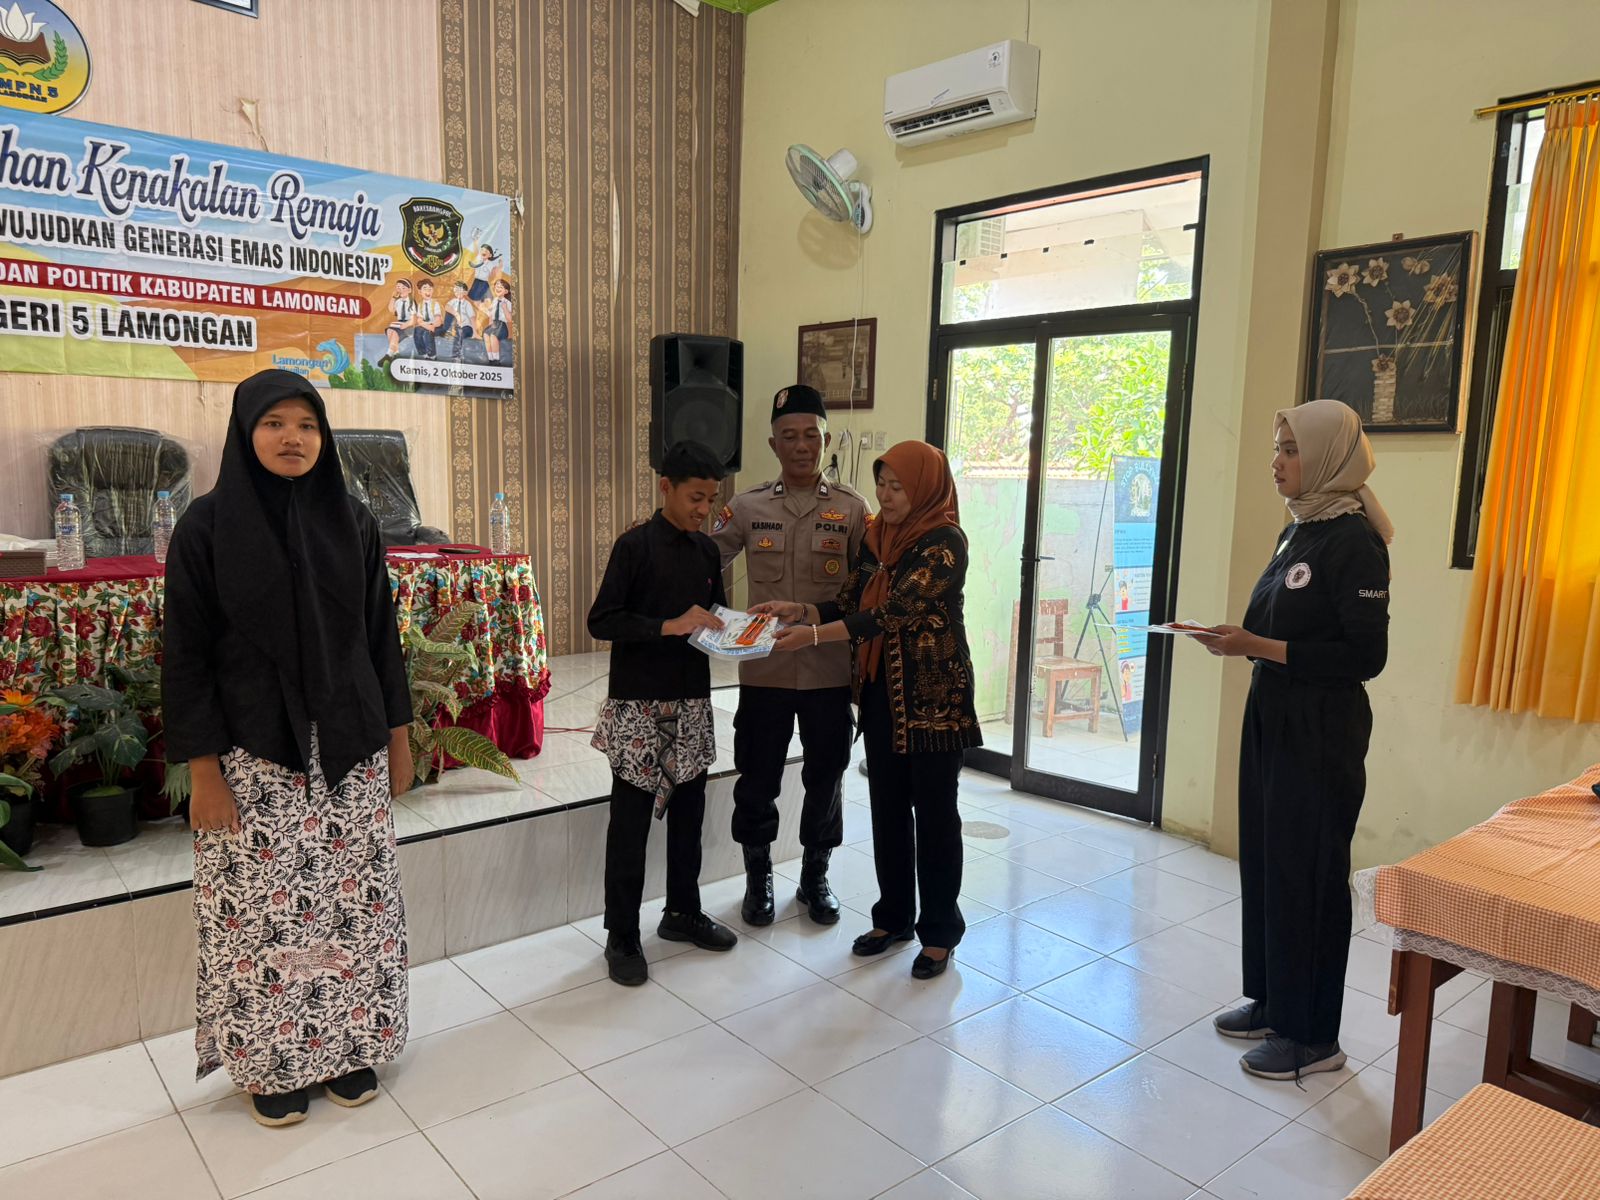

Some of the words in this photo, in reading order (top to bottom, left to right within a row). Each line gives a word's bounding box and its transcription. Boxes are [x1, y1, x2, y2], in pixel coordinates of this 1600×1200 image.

[0, 128, 71, 191] han
[76, 140, 261, 223] Kenakalan
[270, 173, 381, 247] Remaja
[123, 224, 223, 262] GENERASI
[231, 238, 284, 268] EMAS
[47, 267, 133, 294] POLITIK
[139, 276, 255, 305] KABUPATEN
[262, 290, 361, 316] LAMONGAN
[72, 305, 89, 335] 5
[101, 307, 253, 347] LAMONGAN
[399, 364, 431, 378] Kamis,
[433, 367, 439, 377] 2
[440, 368, 478, 380] Oktober
[479, 371, 503, 382] 2025
[815, 522, 848, 534] POLRI
